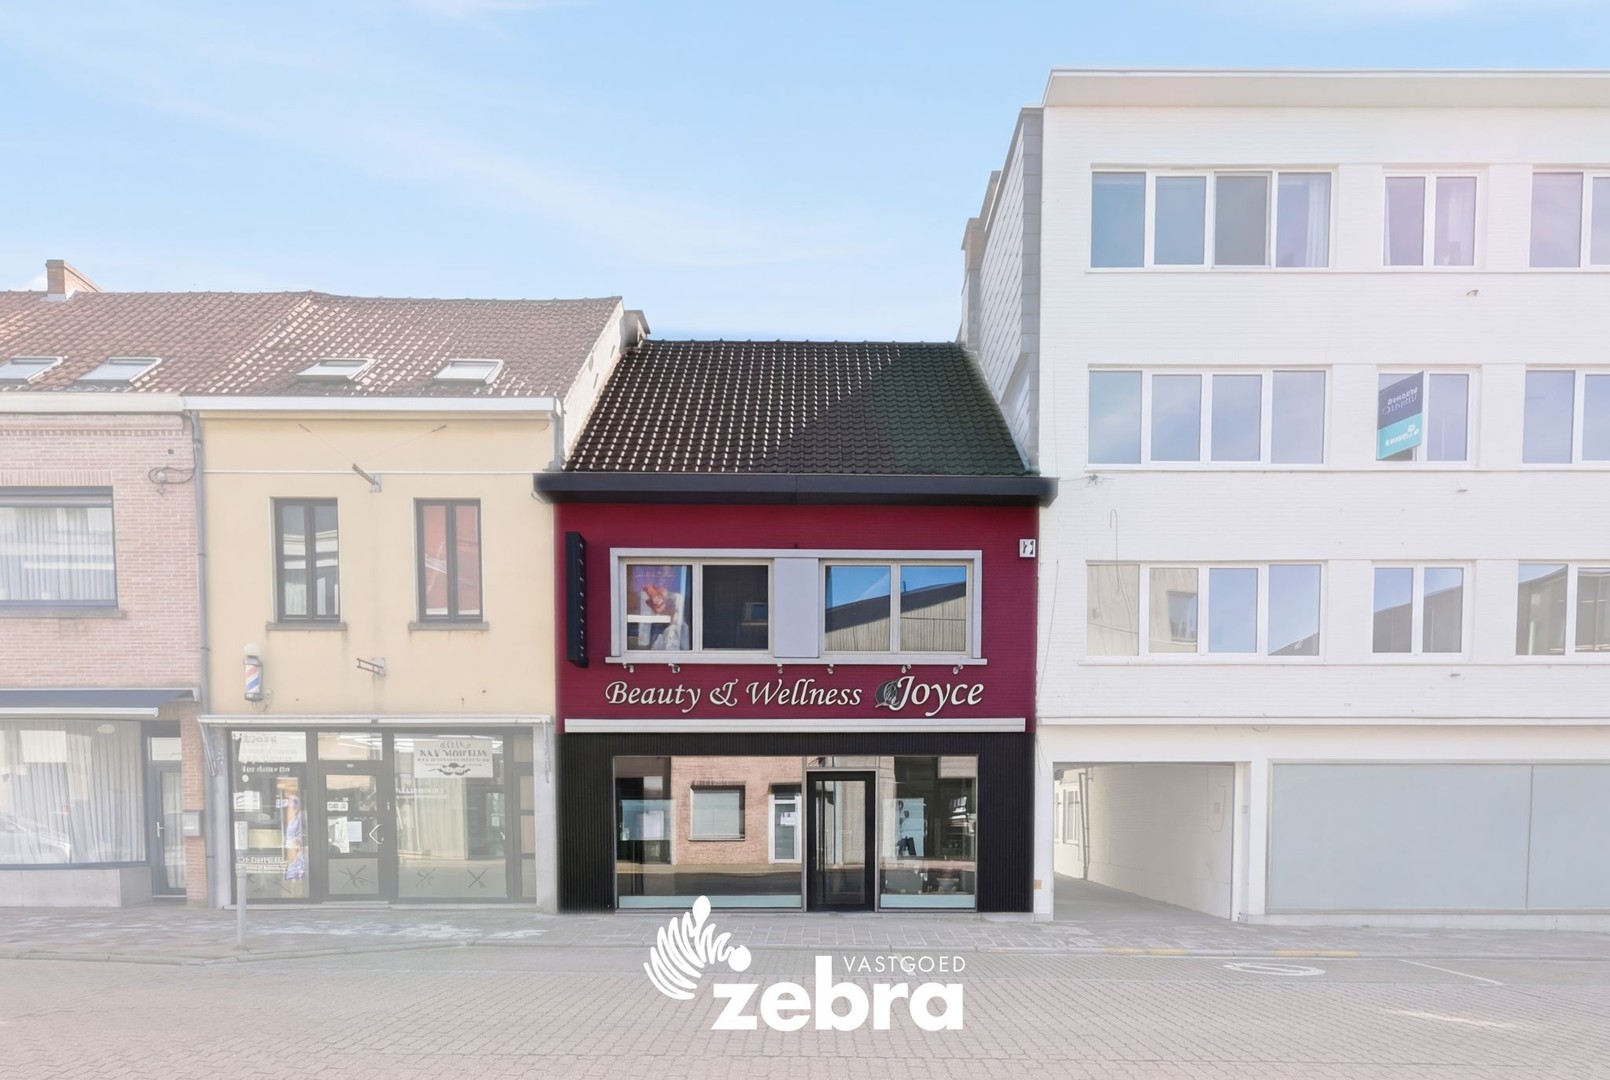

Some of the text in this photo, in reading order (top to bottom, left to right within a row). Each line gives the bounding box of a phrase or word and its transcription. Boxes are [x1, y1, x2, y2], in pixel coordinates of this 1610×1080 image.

[604, 675, 984, 717] Beauty & Wellness Joyce
